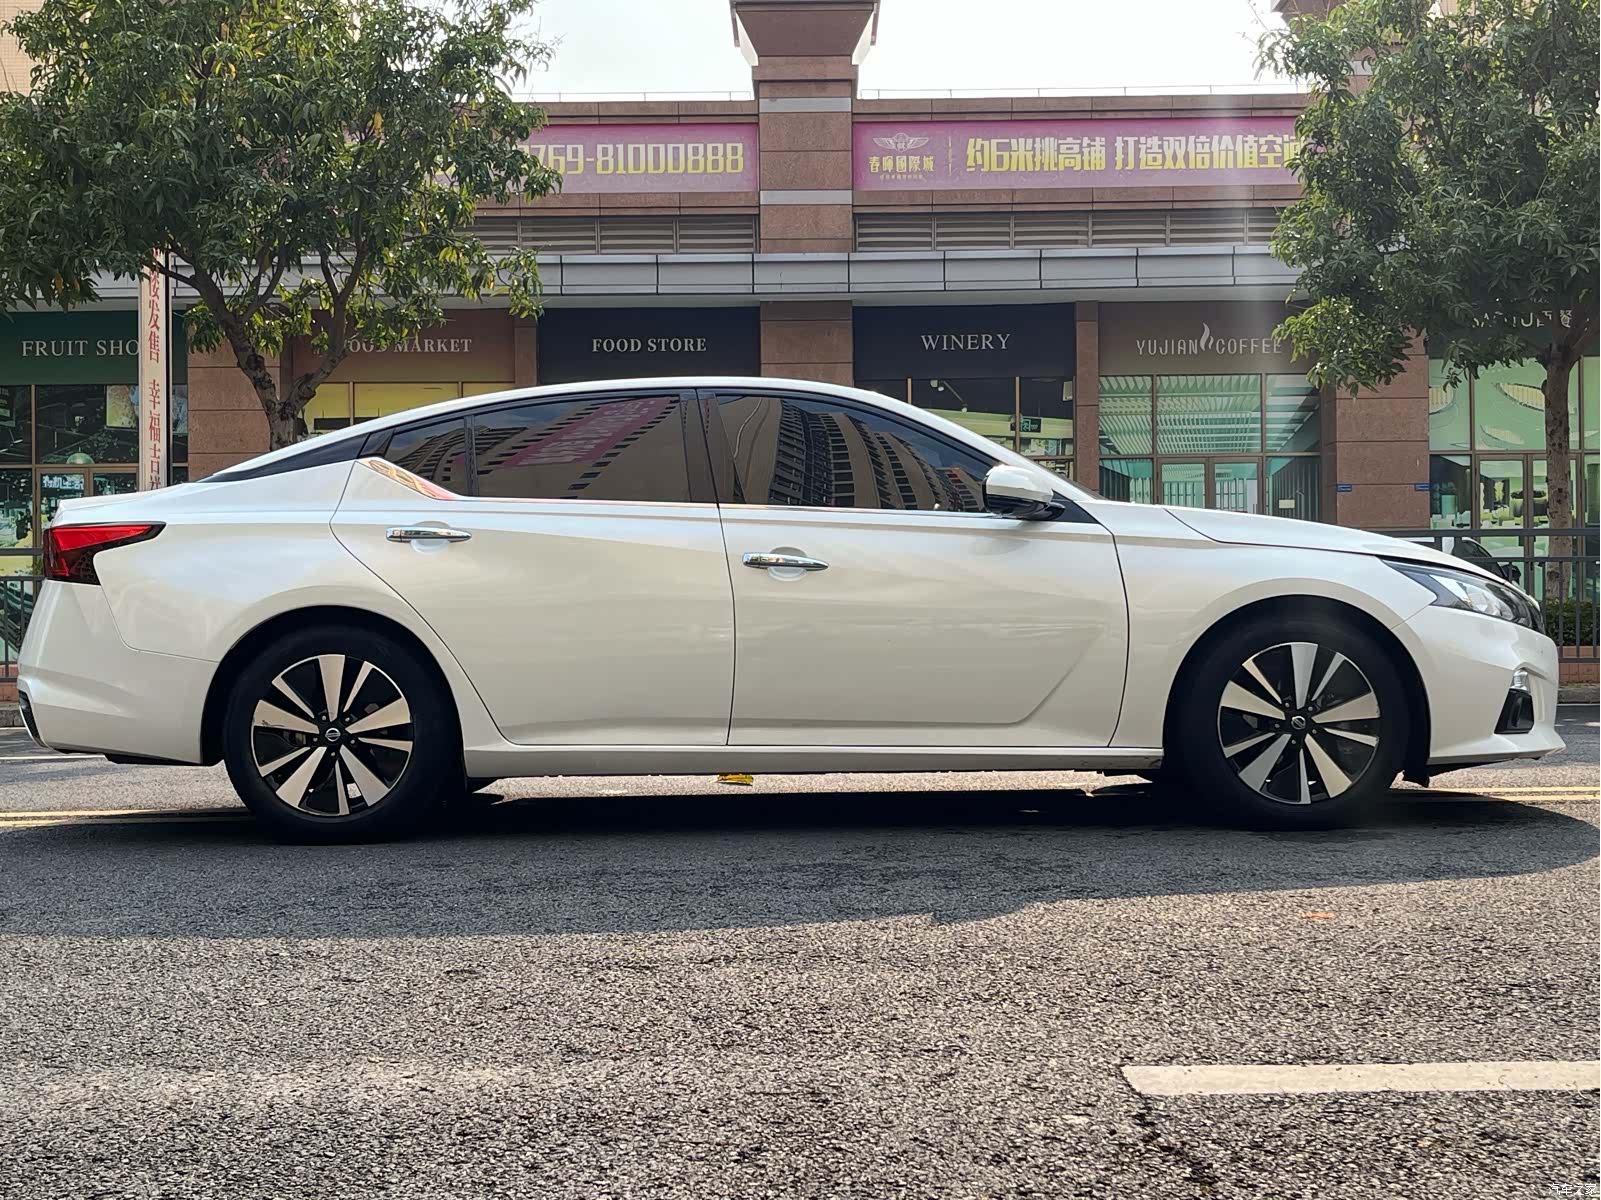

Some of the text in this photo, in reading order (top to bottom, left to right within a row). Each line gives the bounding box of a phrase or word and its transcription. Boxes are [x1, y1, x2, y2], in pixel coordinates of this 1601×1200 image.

[518, 143, 744, 175] 769-81000888
[966, 137, 1106, 171] 约6米挑高铺
[21, 340, 139, 357] FRUIT SHO
[394, 338, 472, 353] MARKET
[592, 338, 707, 352] FOOD STORE
[920, 333, 1011, 351] WINERY
[1136, 338, 1282, 355] YUJIAN COFFEE
